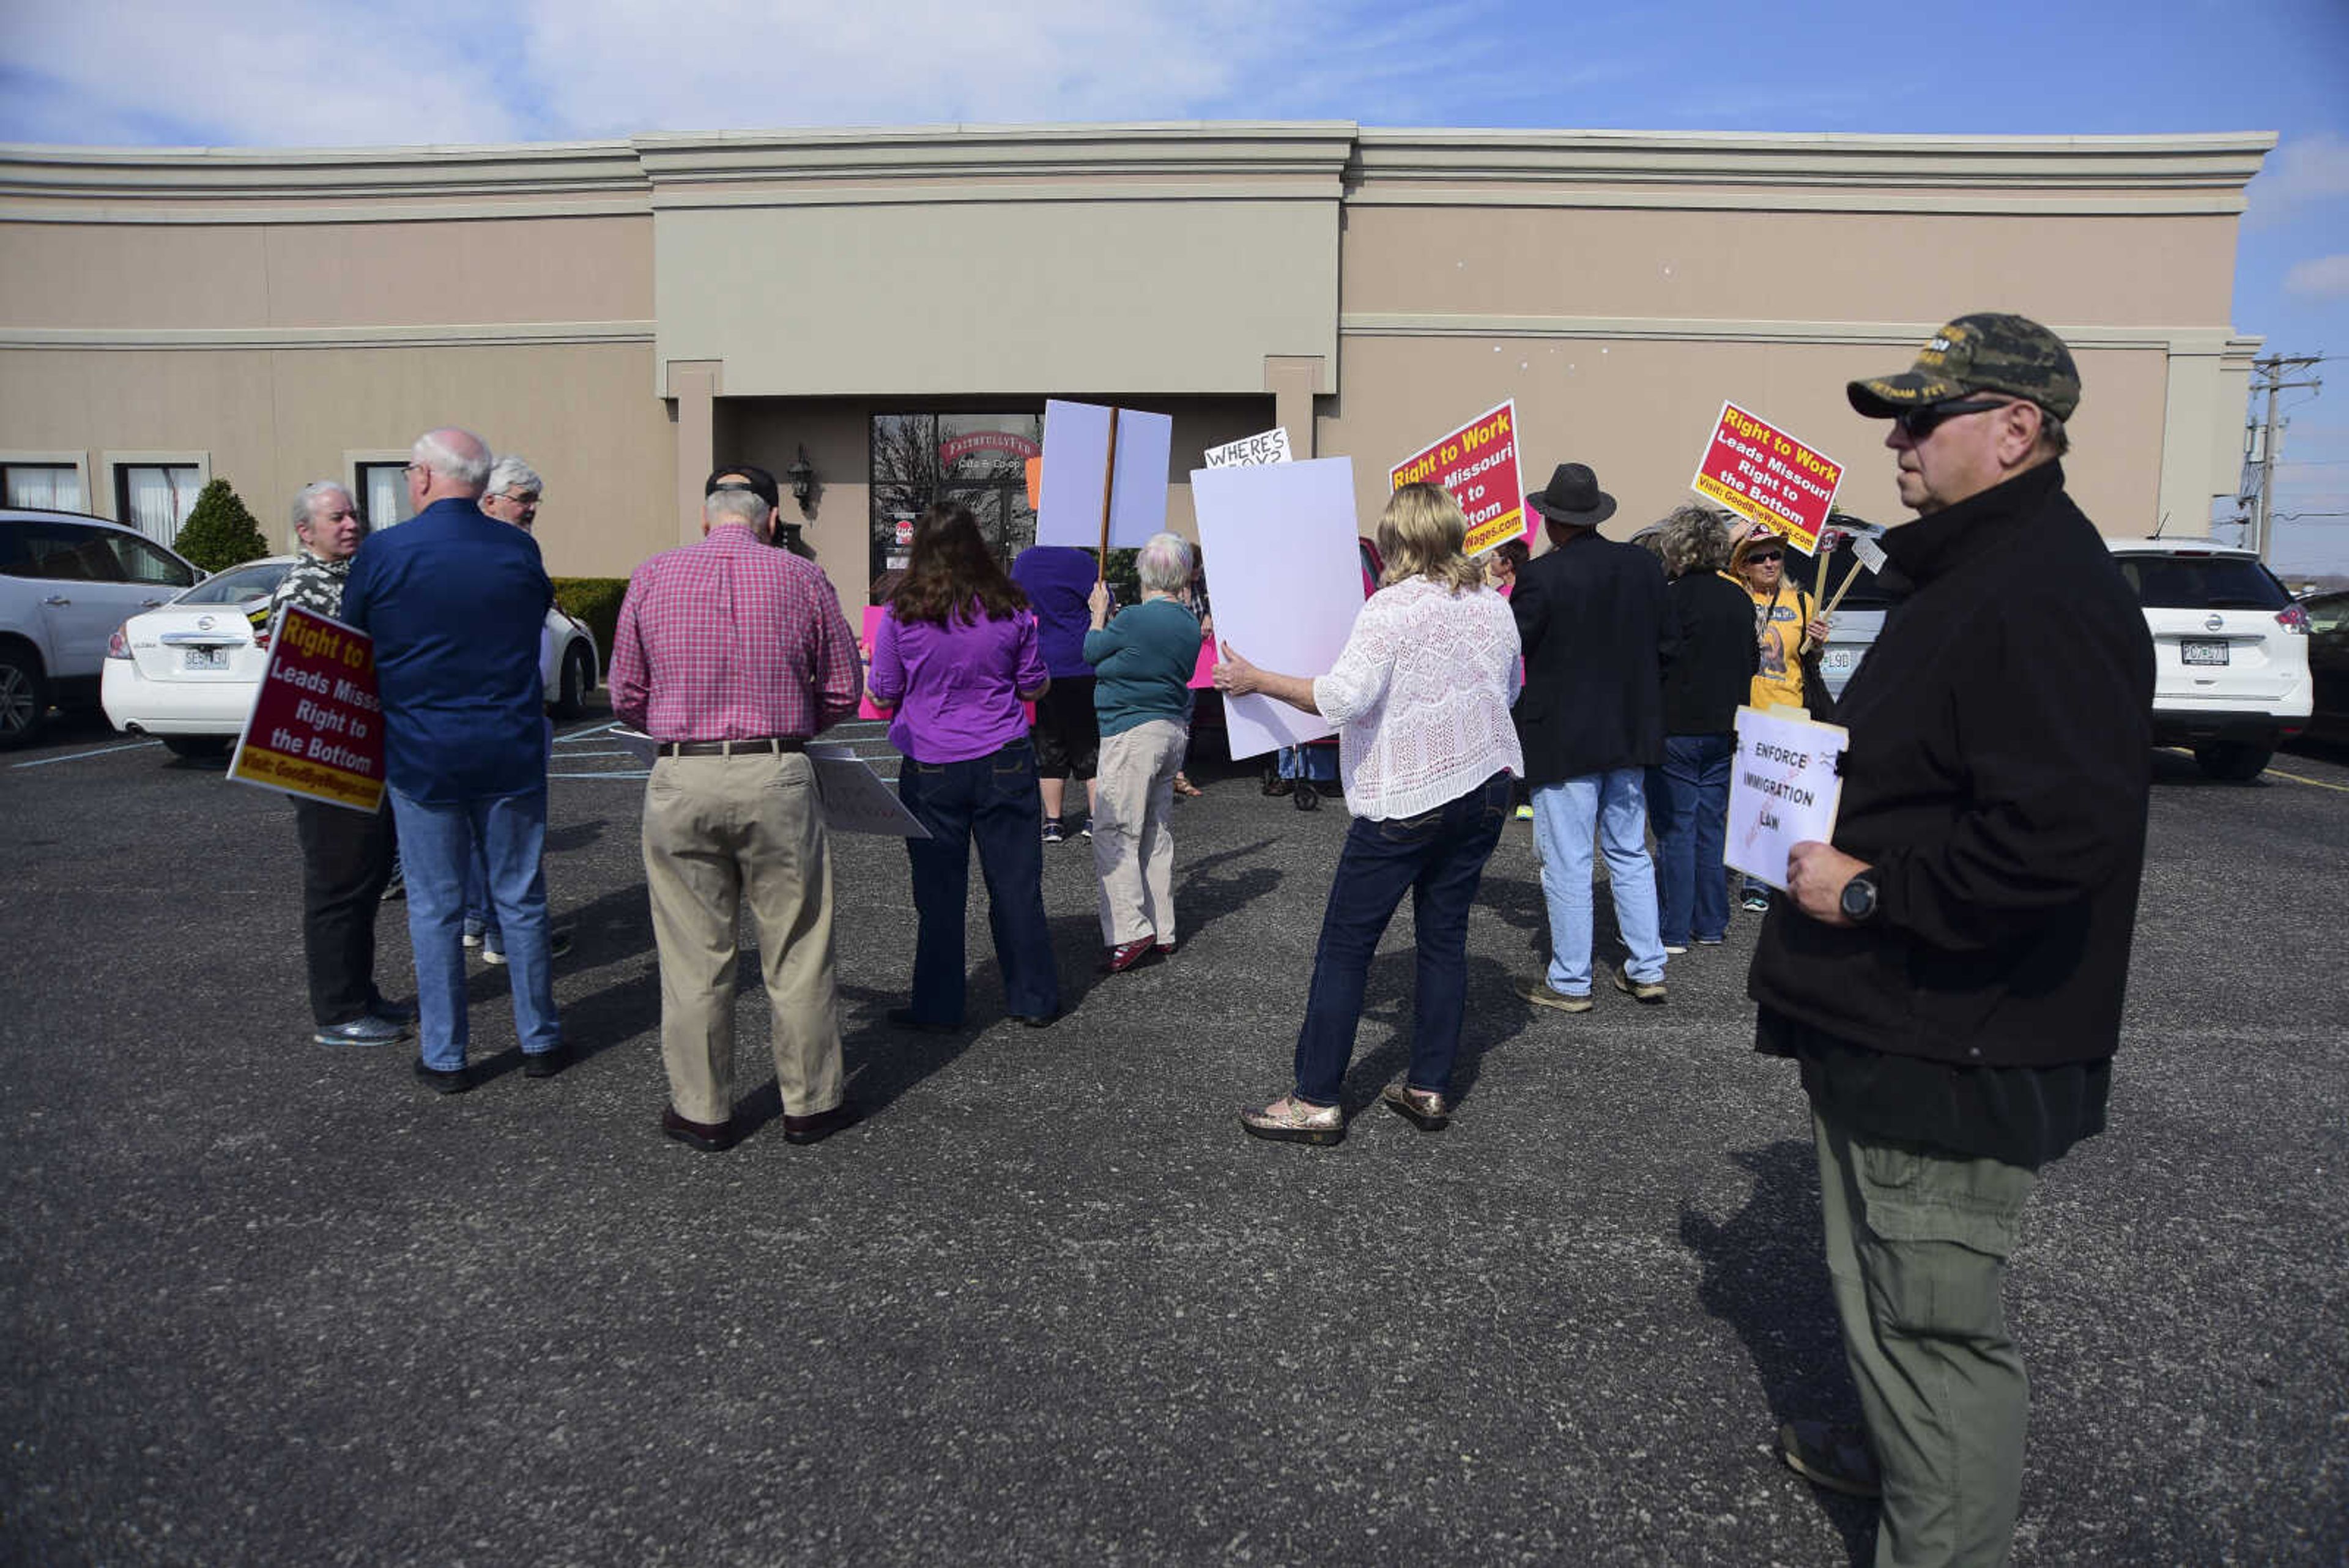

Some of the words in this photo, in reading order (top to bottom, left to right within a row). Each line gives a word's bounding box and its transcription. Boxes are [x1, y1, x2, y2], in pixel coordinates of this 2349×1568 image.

[1206, 431, 1284, 466] WHERE'S
[1393, 454, 1436, 490] Right
[1441, 444, 1458, 466] to
[1462, 414, 1510, 453] Work
[1444, 442, 1513, 488] Missouri
[1717, 429, 1765, 463] Leads
[1767, 457, 1831, 502] Missouri
[1723, 407, 1771, 445] Right
[1773, 437, 1791, 456] to
[1796, 448, 1838, 484] Work
[1468, 485, 1485, 502] to
[1720, 470, 1746, 491] the
[1748, 485, 1805, 526] Bottom
[1738, 459, 1780, 490] Right
[1783, 485, 1798, 501] to
[282, 615, 340, 658] Right
[343, 641, 364, 668] to
[270, 656, 330, 694] Leads
[295, 699, 346, 732] Right
[351, 719, 367, 739] to
[270, 728, 305, 753] the
[308, 738, 372, 773] Bottom
[1756, 741, 1808, 769] ENFORCE
[1743, 770, 1816, 808] IMMIGRATION
[1760, 810, 1780, 832] LAW
